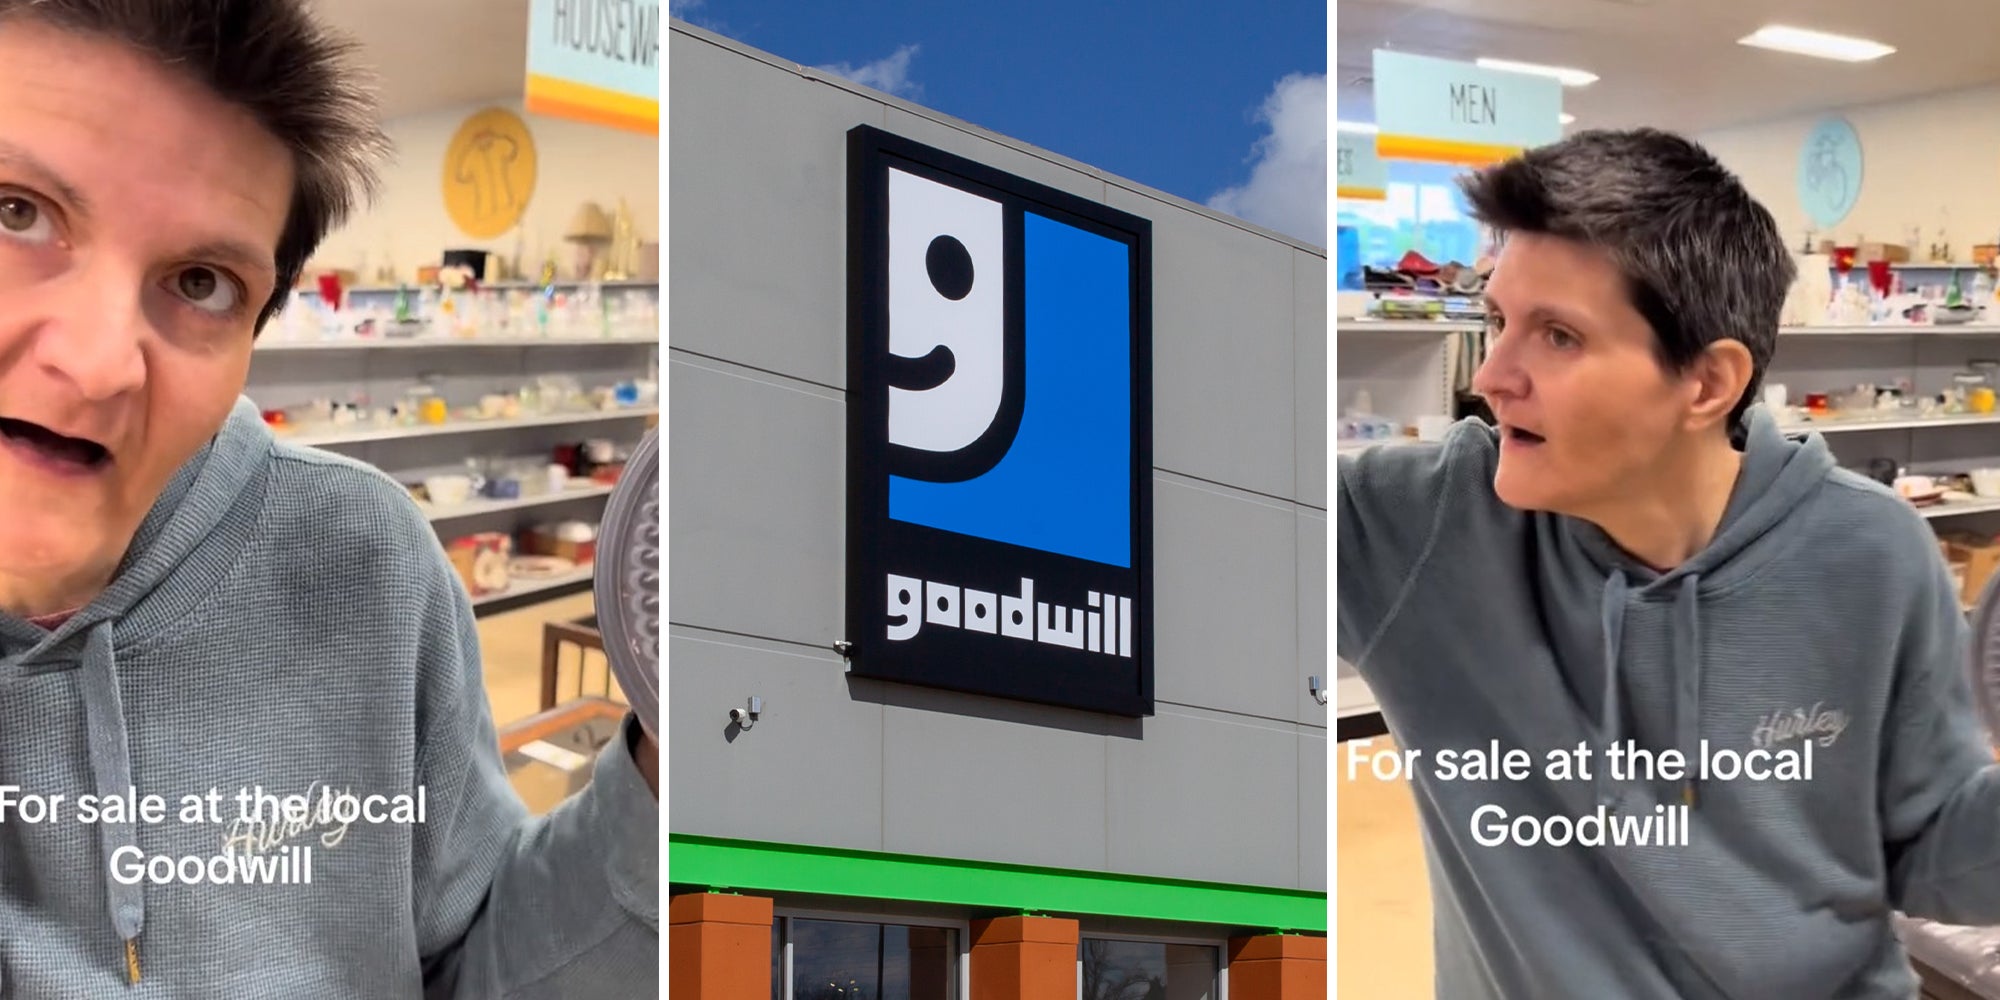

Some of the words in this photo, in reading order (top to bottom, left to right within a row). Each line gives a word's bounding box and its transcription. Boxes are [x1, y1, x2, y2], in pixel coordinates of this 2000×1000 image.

[1449, 83, 1496, 126] MEN
[887, 573, 1132, 658] goodwill
[1752, 700, 1850, 748] Hurley
